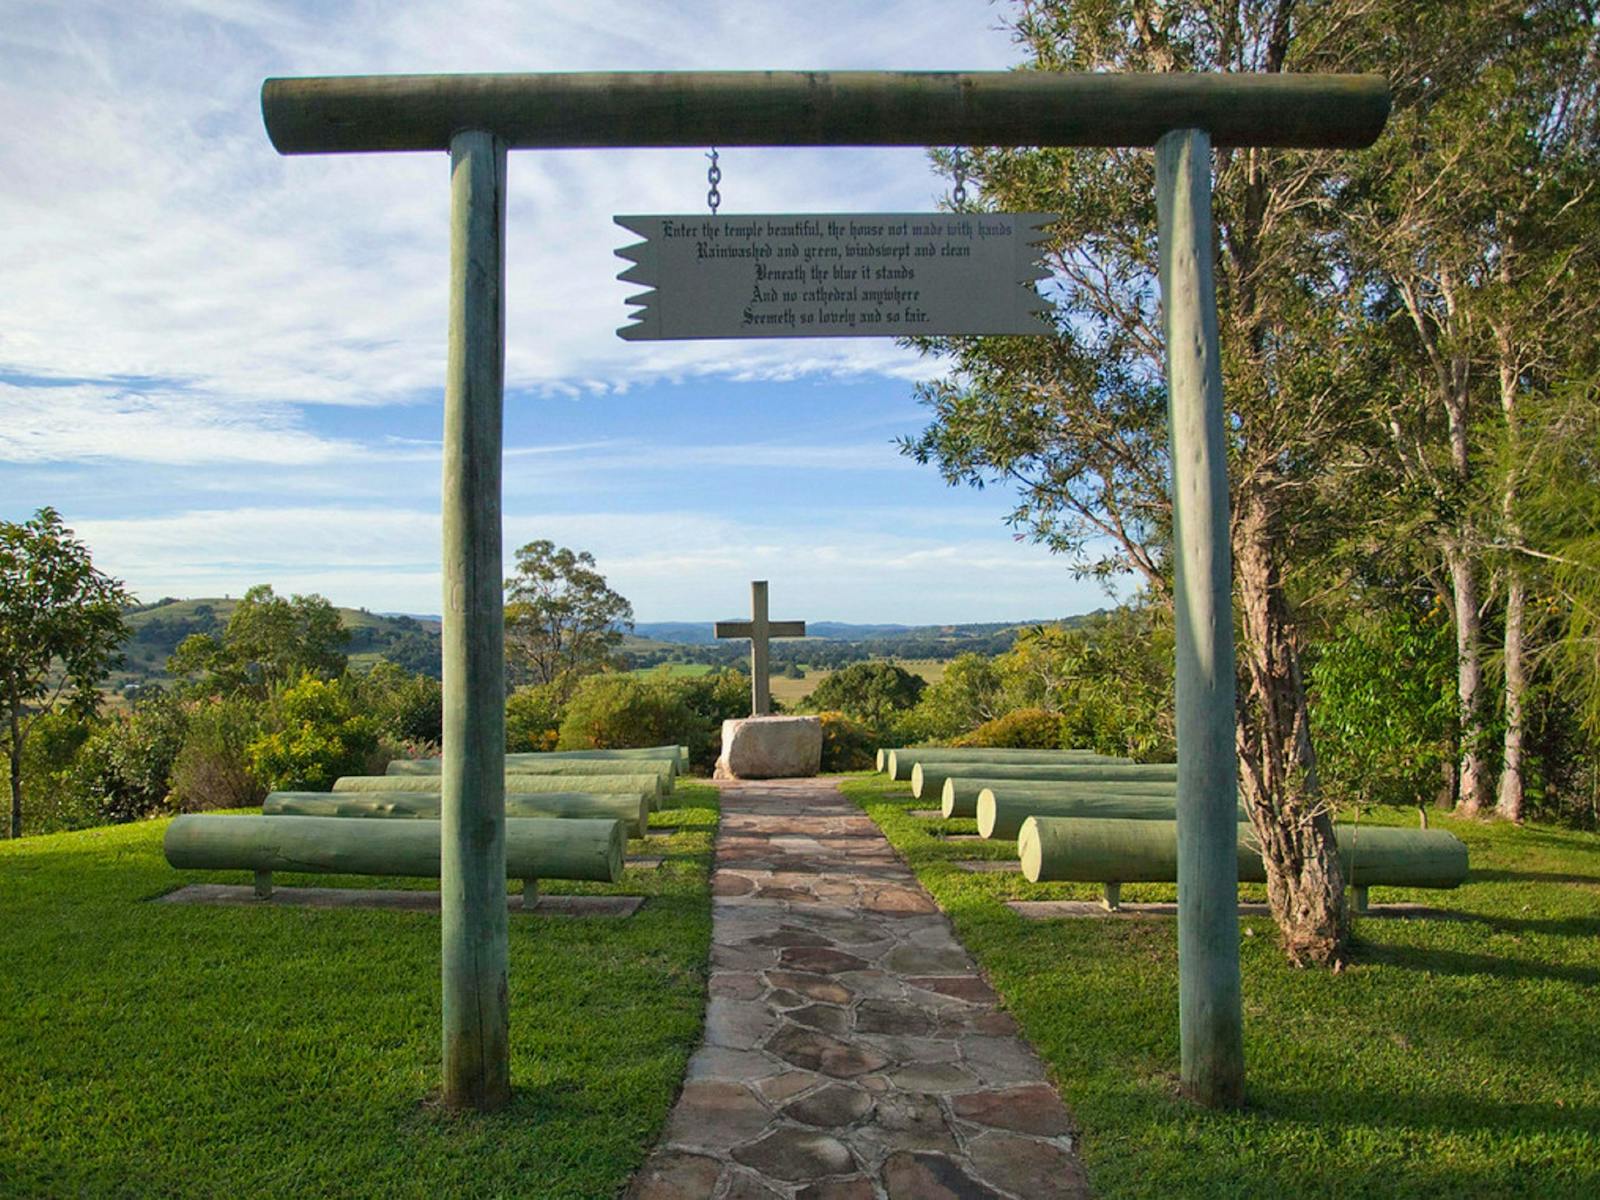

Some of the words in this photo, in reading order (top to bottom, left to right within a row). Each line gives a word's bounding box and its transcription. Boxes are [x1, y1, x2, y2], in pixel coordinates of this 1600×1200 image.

[662, 220, 698, 239] Enter
[702, 220, 719, 240] the
[724, 221, 763, 240] temple
[767, 220, 824, 238] beautiful,
[828, 220, 845, 240] the
[850, 221, 884, 240] house
[888, 221, 907, 236] not
[912, 221, 943, 236] made
[947, 221, 973, 239] with
[978, 221, 1012, 240] hands
[696, 241, 772, 263] Rainwashed
[777, 242, 800, 258] and
[804, 247, 842, 262] green,
[845, 242, 910, 261] windswept
[914, 242, 936, 257] and
[941, 242, 970, 257] clean
[755, 263, 806, 286] Beneath
[811, 264, 828, 284] the
[833, 264, 856, 280] blue
[861, 265, 871, 280] it
[876, 265, 915, 280] stands
[751, 285, 778, 304] And
[782, 293, 798, 302] no
[802, 286, 857, 305] cathedral
[862, 286, 920, 305] anywhere
[741, 305, 795, 328] Seemeth
[799, 313, 814, 324] so
[818, 307, 856, 327] lovely
[860, 308, 882, 323] and
[887, 312, 900, 323] so
[904, 306, 930, 323] fair.
